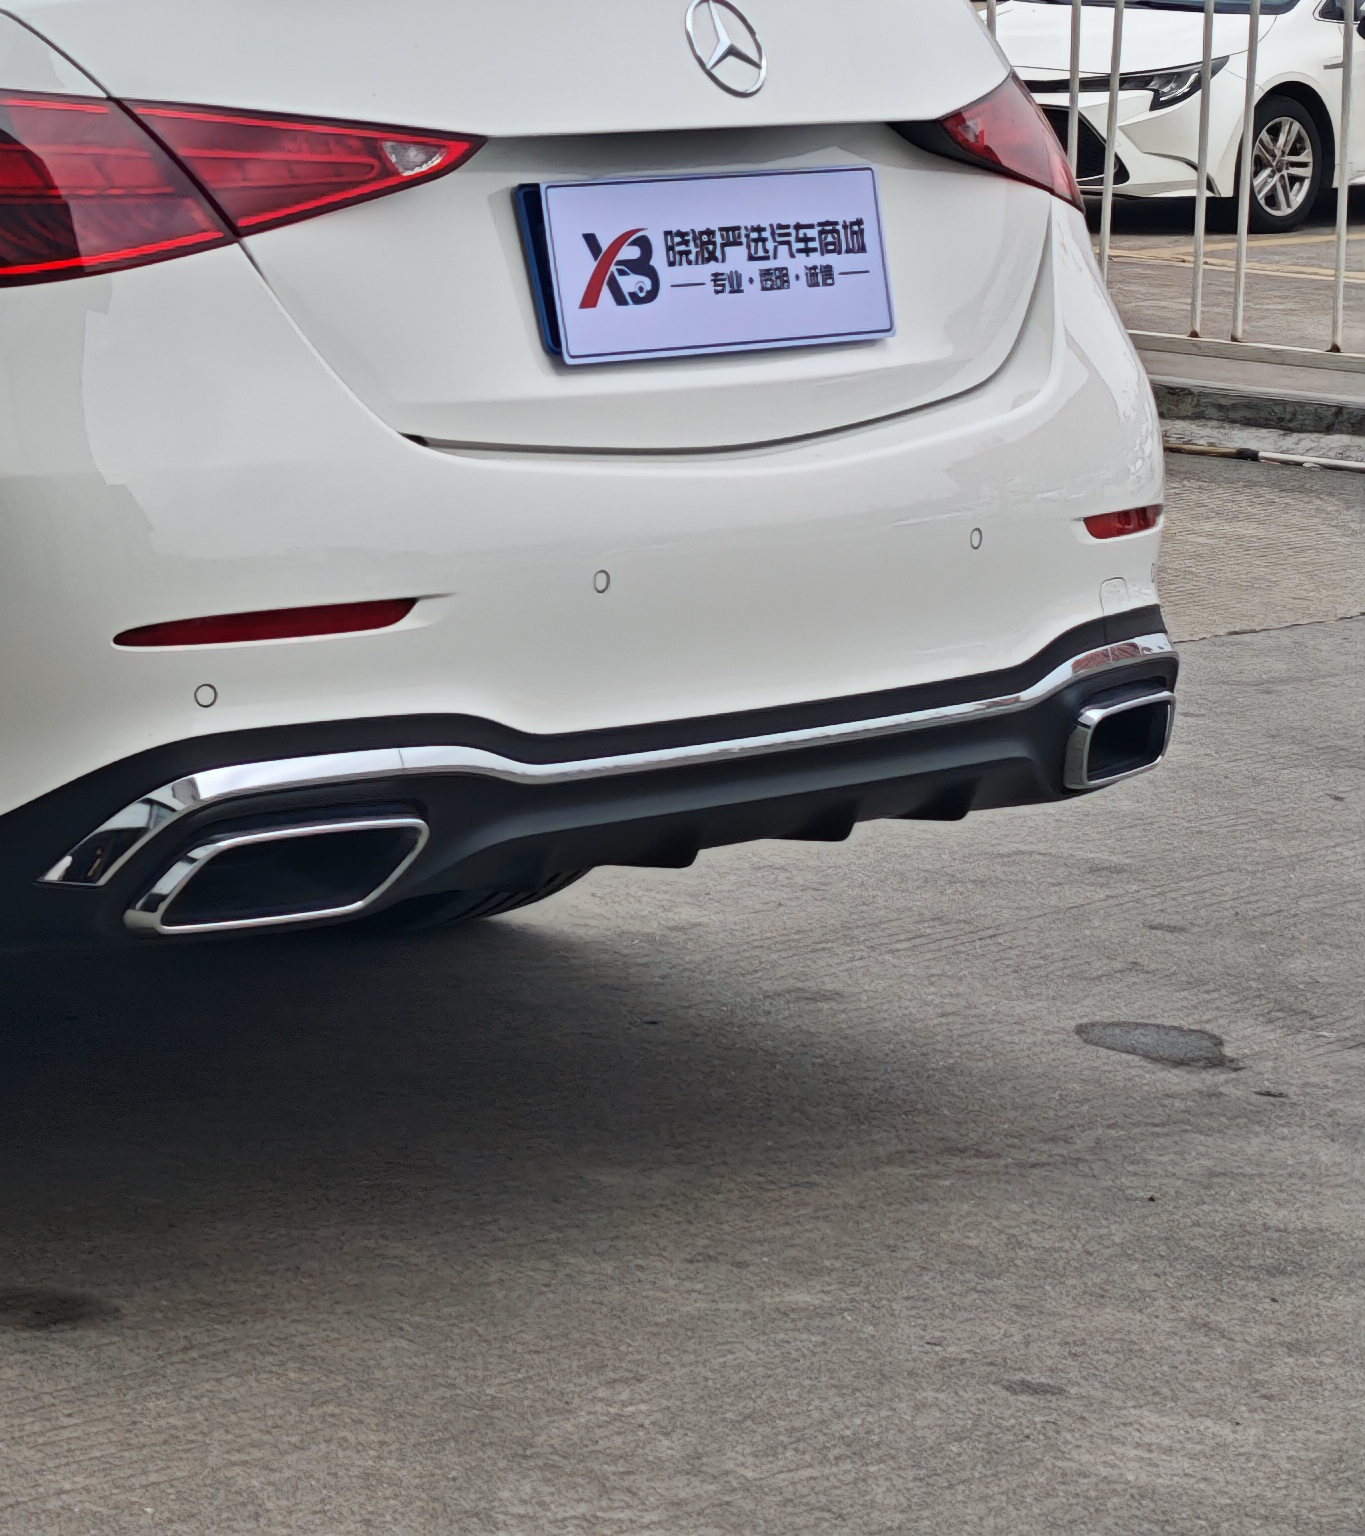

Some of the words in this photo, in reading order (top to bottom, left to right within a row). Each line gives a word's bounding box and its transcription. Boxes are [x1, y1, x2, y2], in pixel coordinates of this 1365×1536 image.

[663, 217, 868, 267] 晓波严选汽车商城
